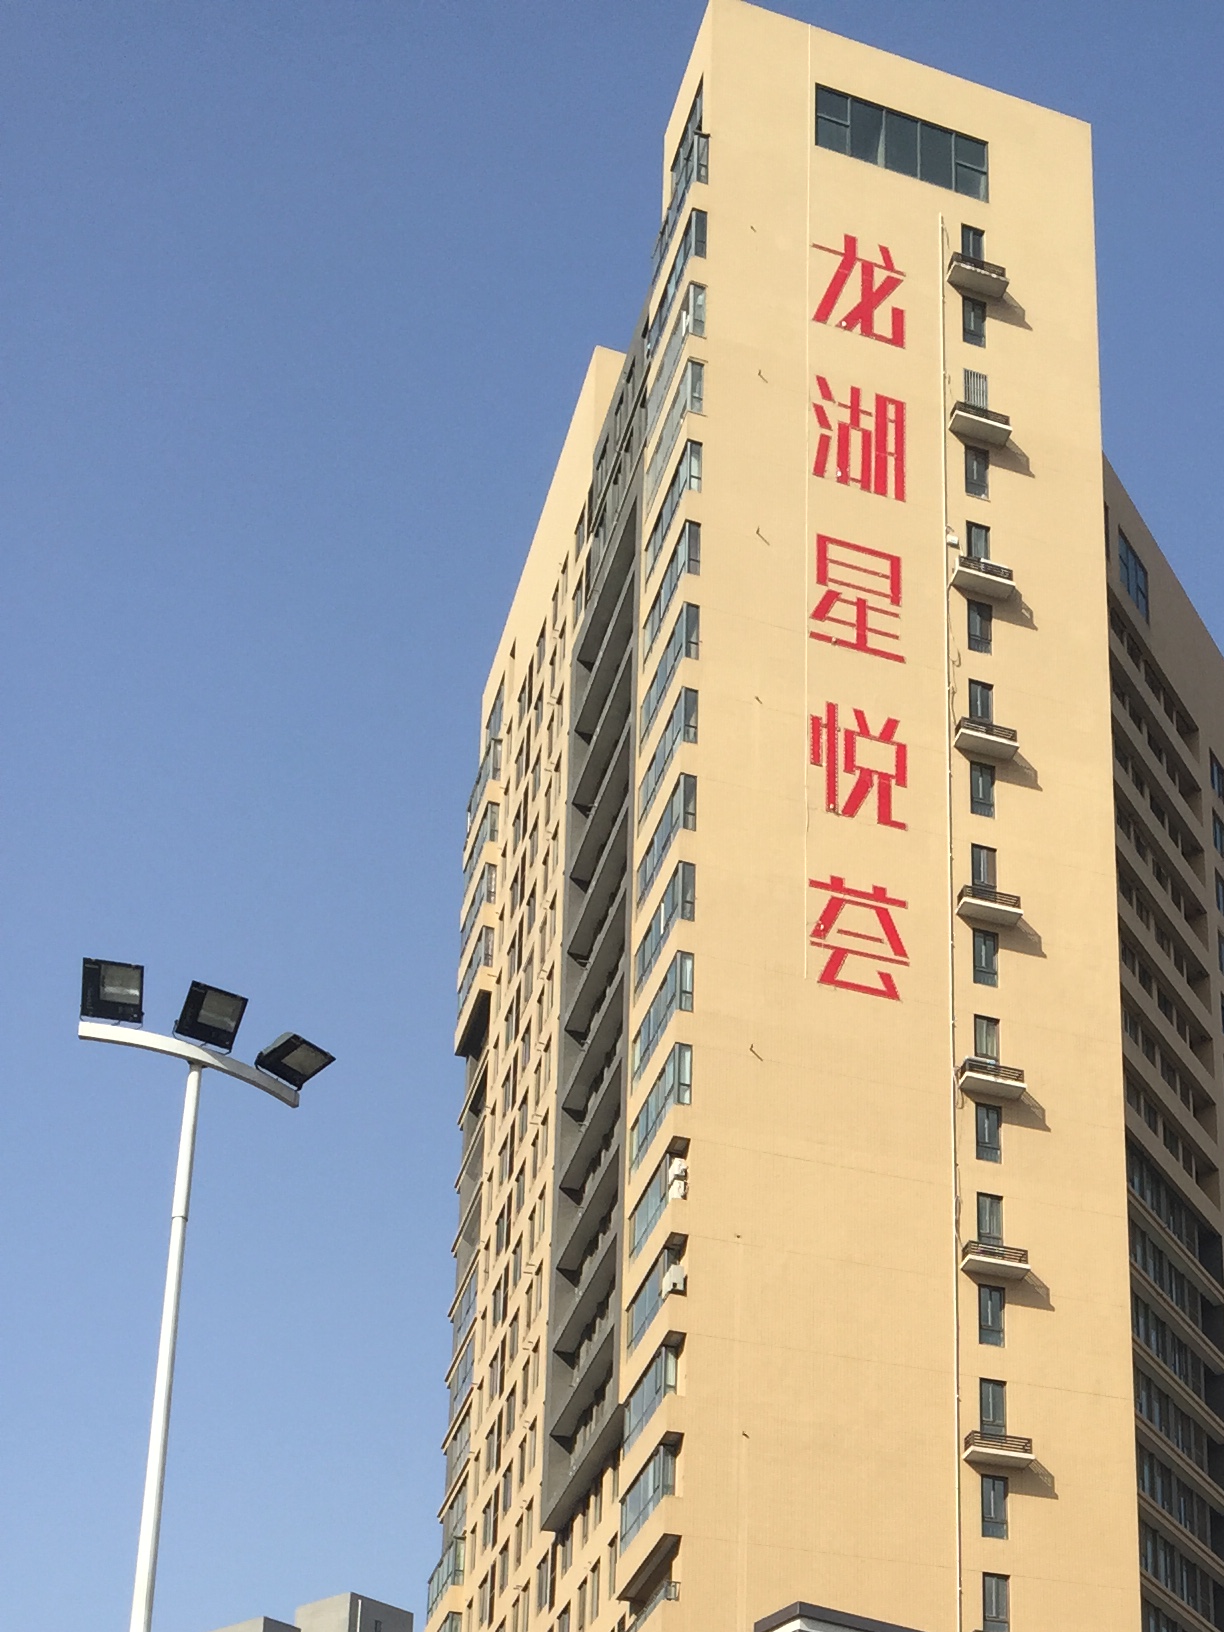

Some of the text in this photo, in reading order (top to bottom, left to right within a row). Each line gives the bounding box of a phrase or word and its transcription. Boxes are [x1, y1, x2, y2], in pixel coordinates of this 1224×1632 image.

[808, 233, 910, 1001] 龙湖星悦荟
